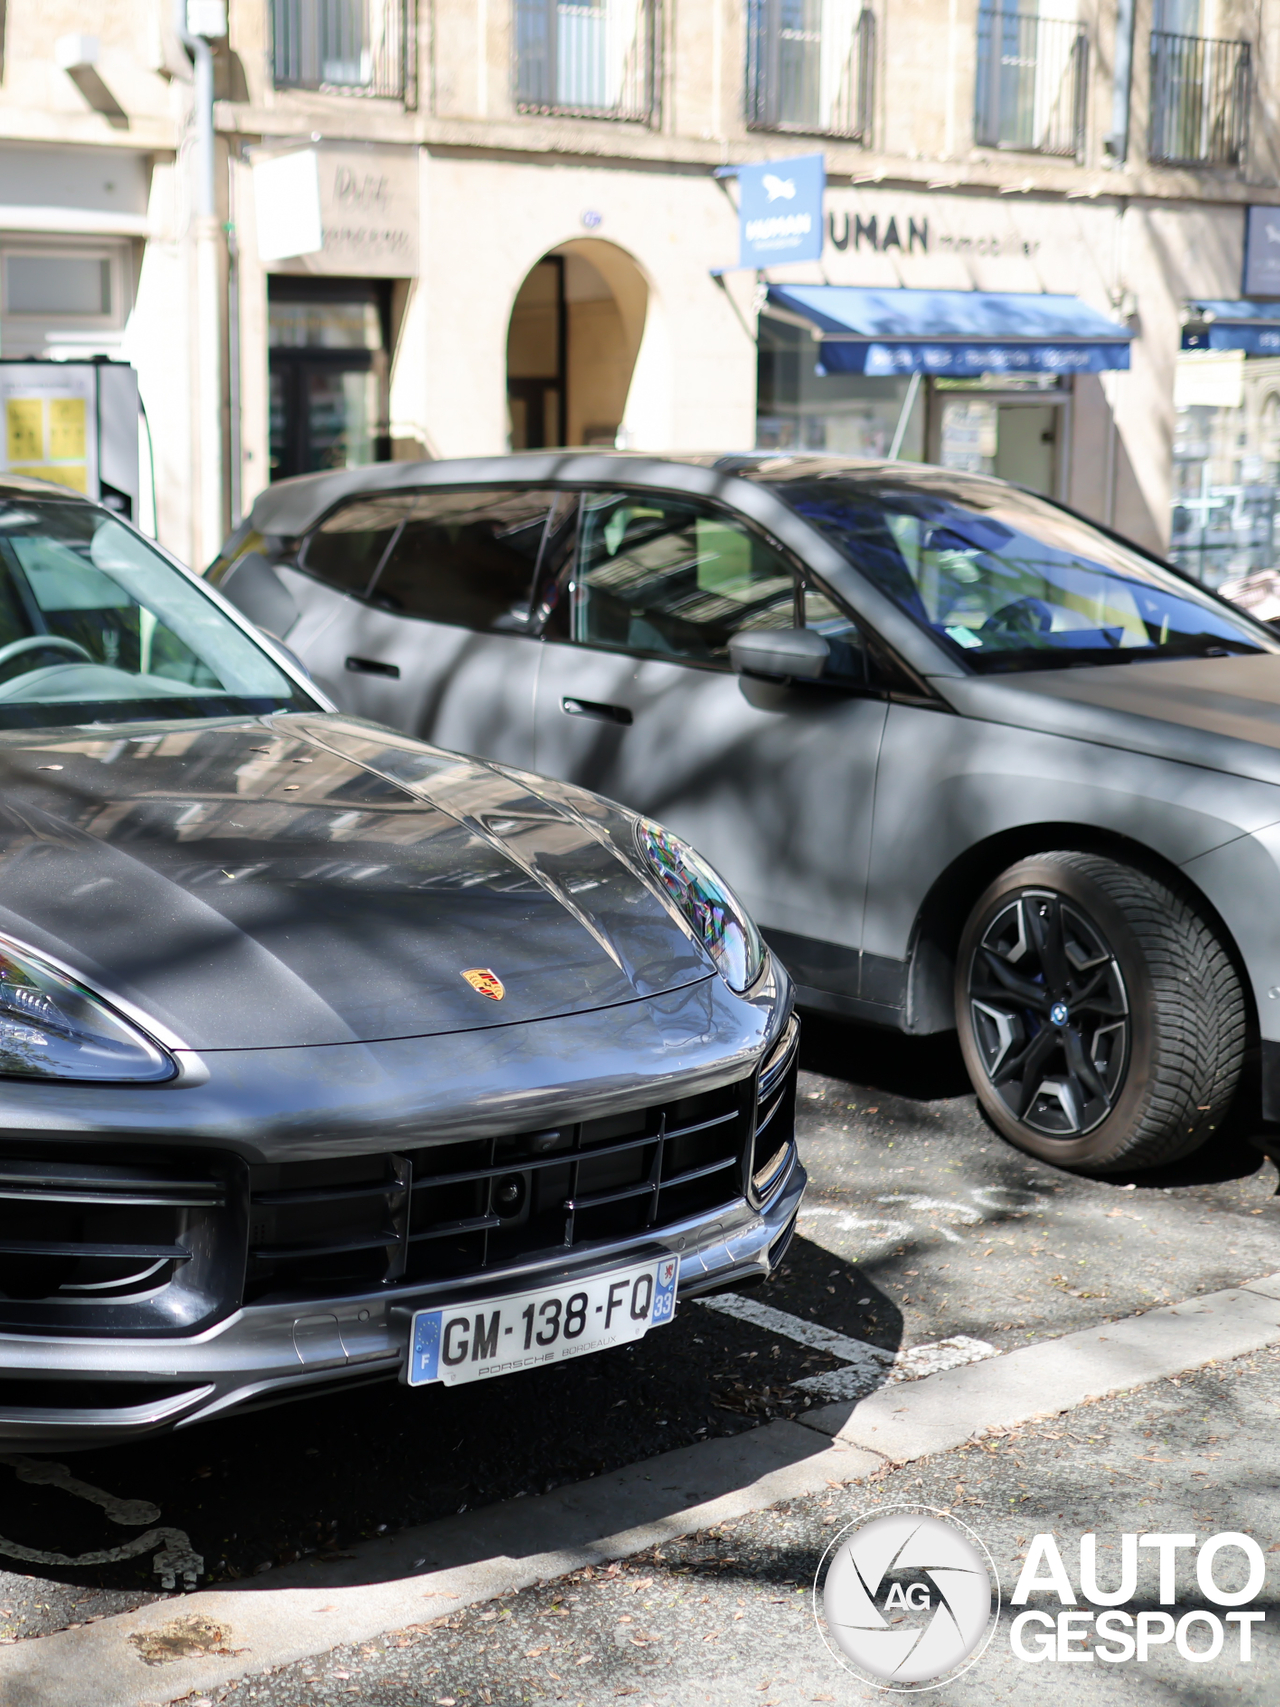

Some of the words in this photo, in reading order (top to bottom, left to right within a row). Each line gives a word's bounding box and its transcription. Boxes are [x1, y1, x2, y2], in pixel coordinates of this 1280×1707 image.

[829, 211, 928, 253] UMAN
[654, 1292, 673, 1317] 33
[421, 1353, 431, 1370] F
[478, 1351, 555, 1377] PORSCHE
[562, 1335, 617, 1358] BORDEAUX
